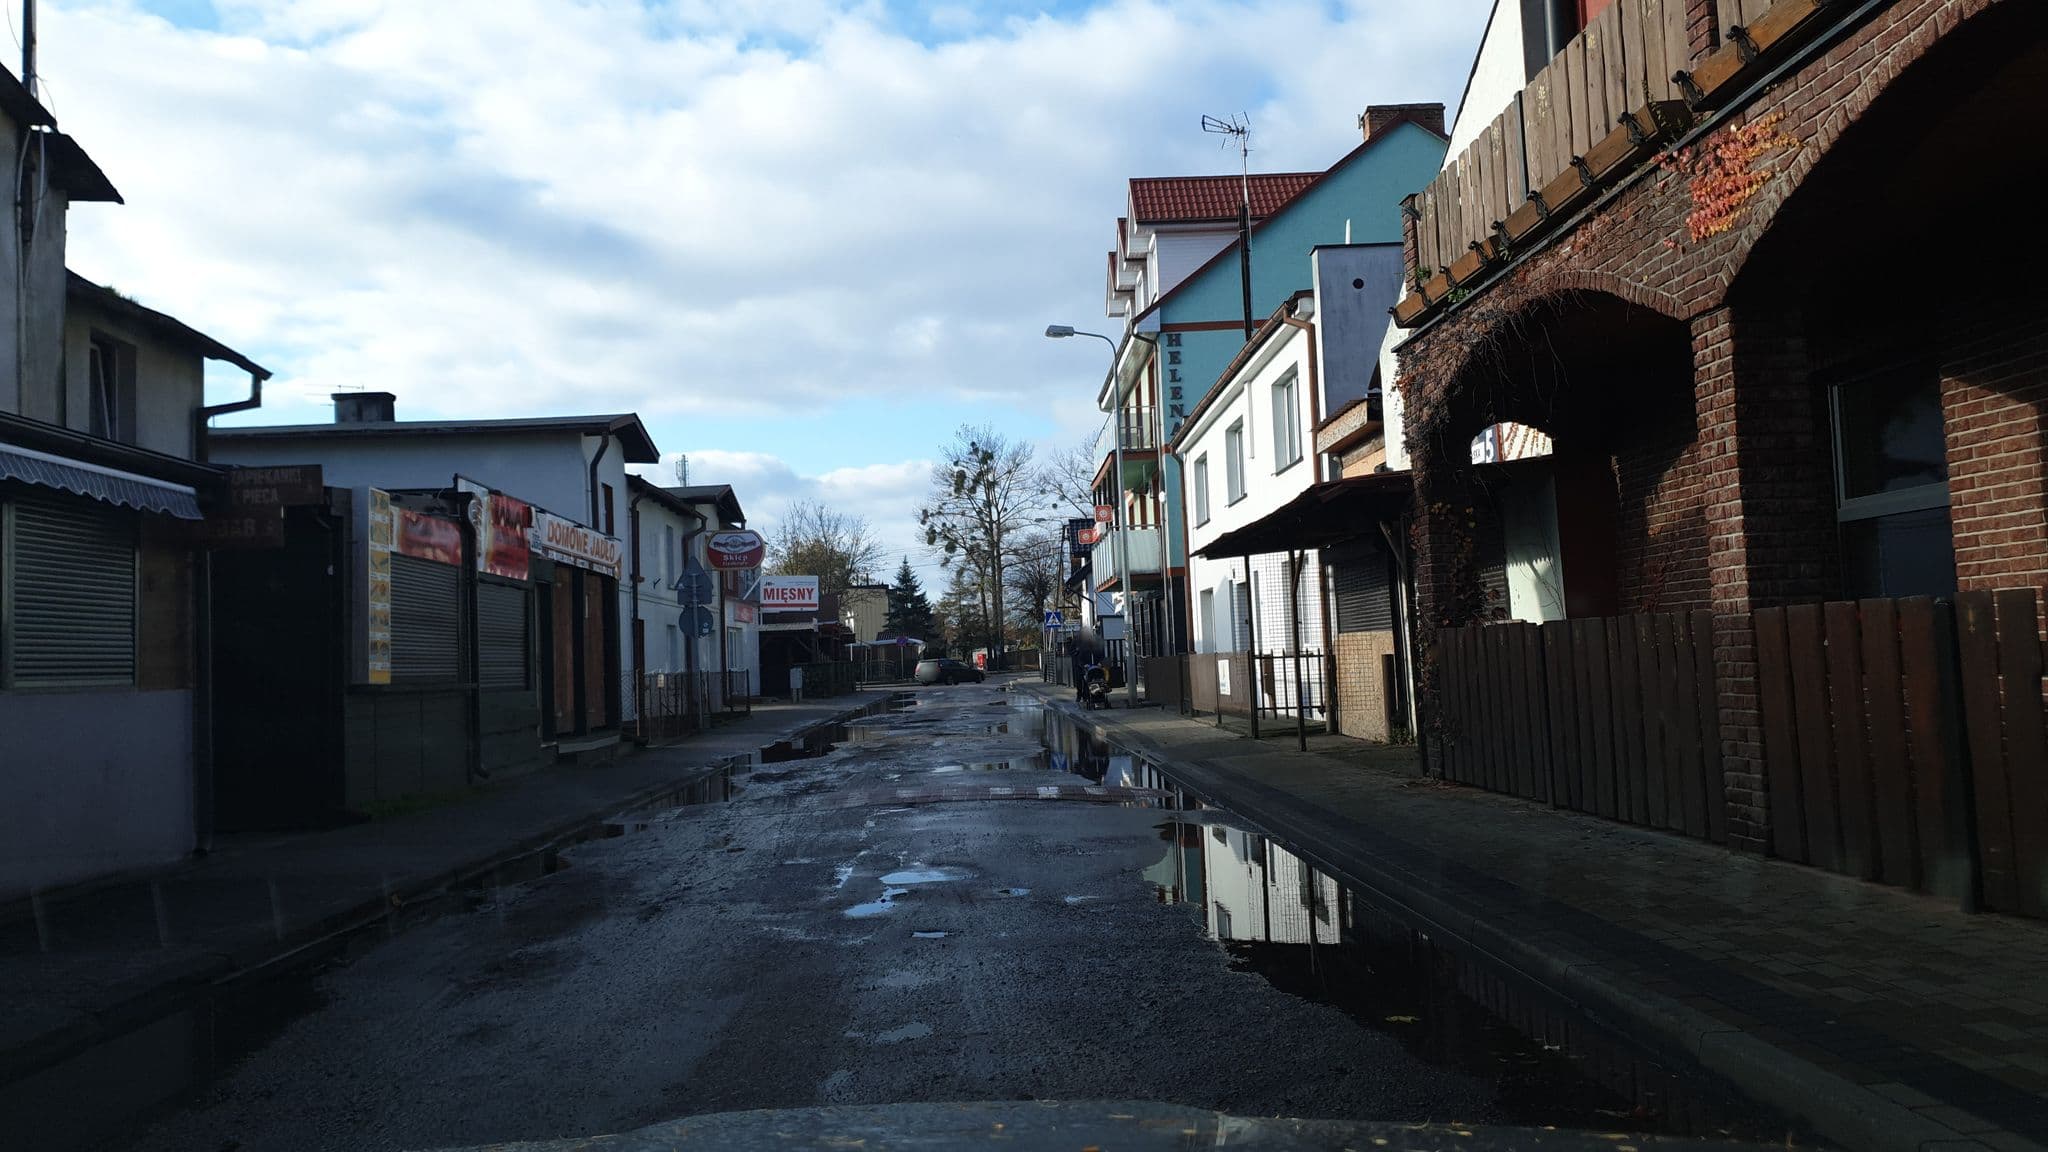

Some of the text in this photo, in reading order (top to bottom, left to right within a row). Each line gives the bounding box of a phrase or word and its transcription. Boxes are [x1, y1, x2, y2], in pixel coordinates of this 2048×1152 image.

[1167, 333, 1184, 435] HELENA
[548, 520, 588, 553] DOMOWE
[723, 554, 748, 562] Sklep
[764, 588, 814, 603] MIĘSNY
